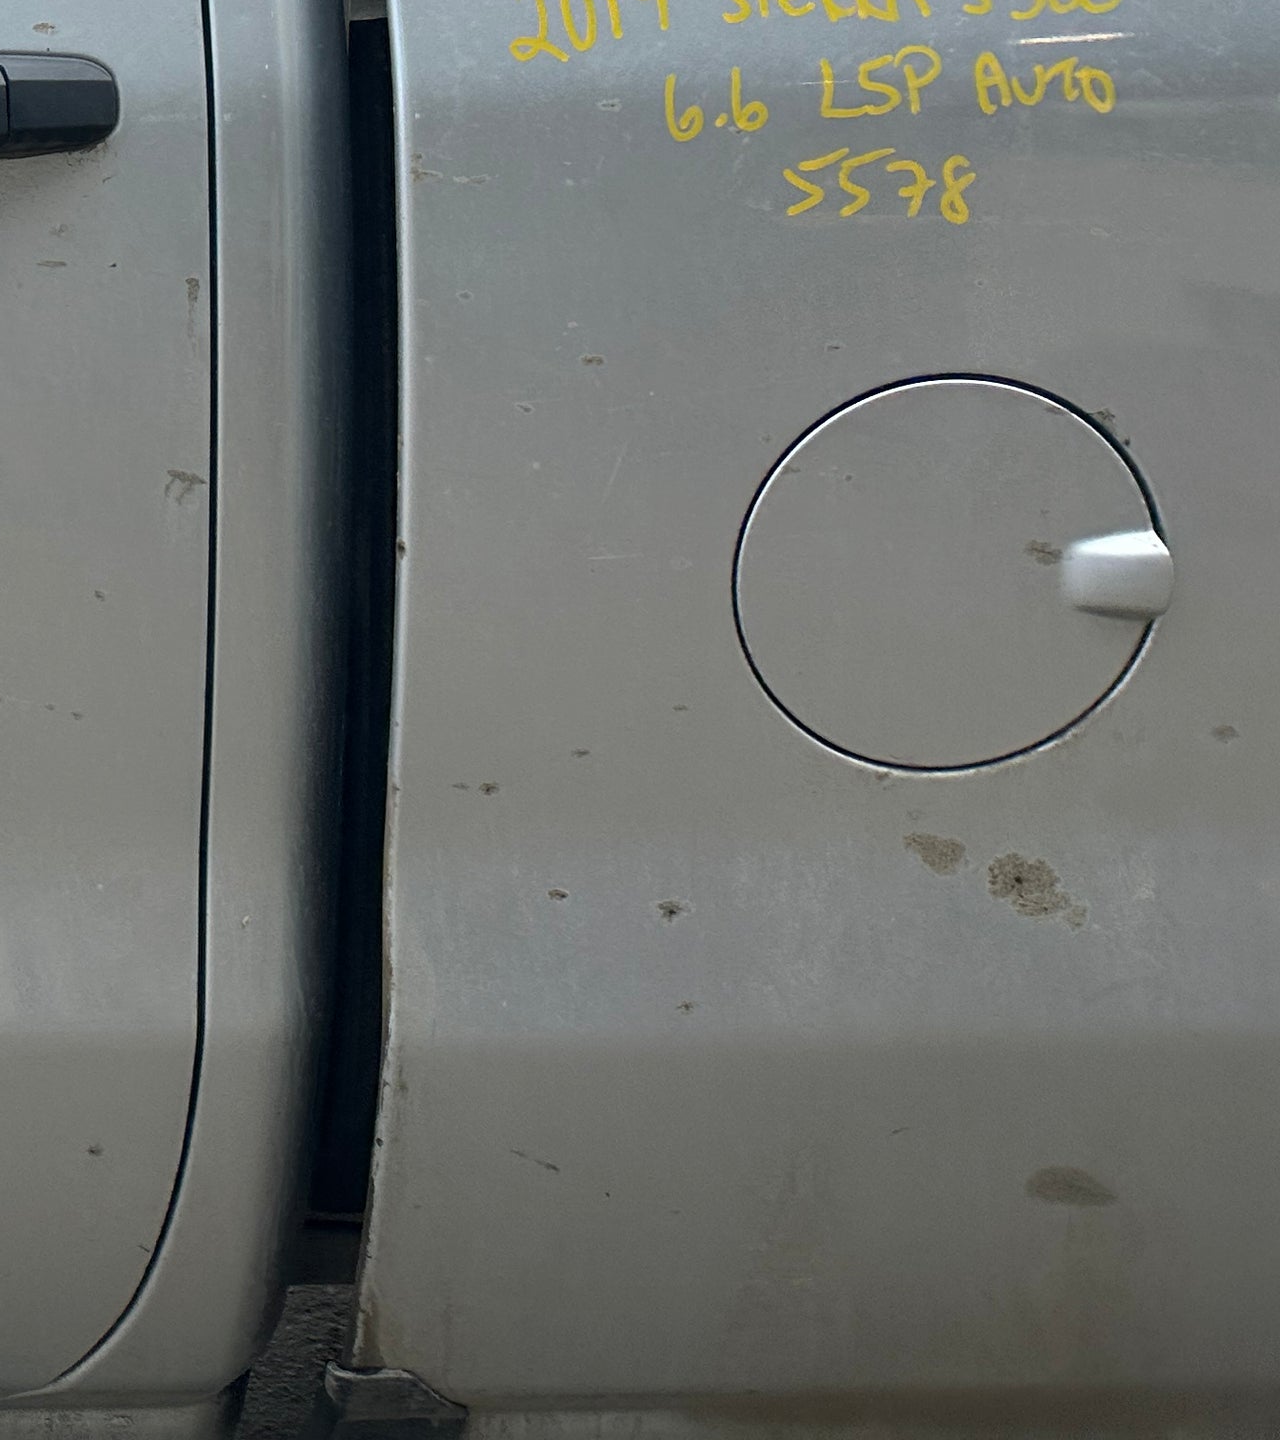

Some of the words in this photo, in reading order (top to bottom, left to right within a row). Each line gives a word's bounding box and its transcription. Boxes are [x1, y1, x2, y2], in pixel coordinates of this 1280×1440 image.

[664, 67, 770, 143] 6.6
[973, 50, 1118, 116] AUTO
[782, 147, 978, 226] 5578
